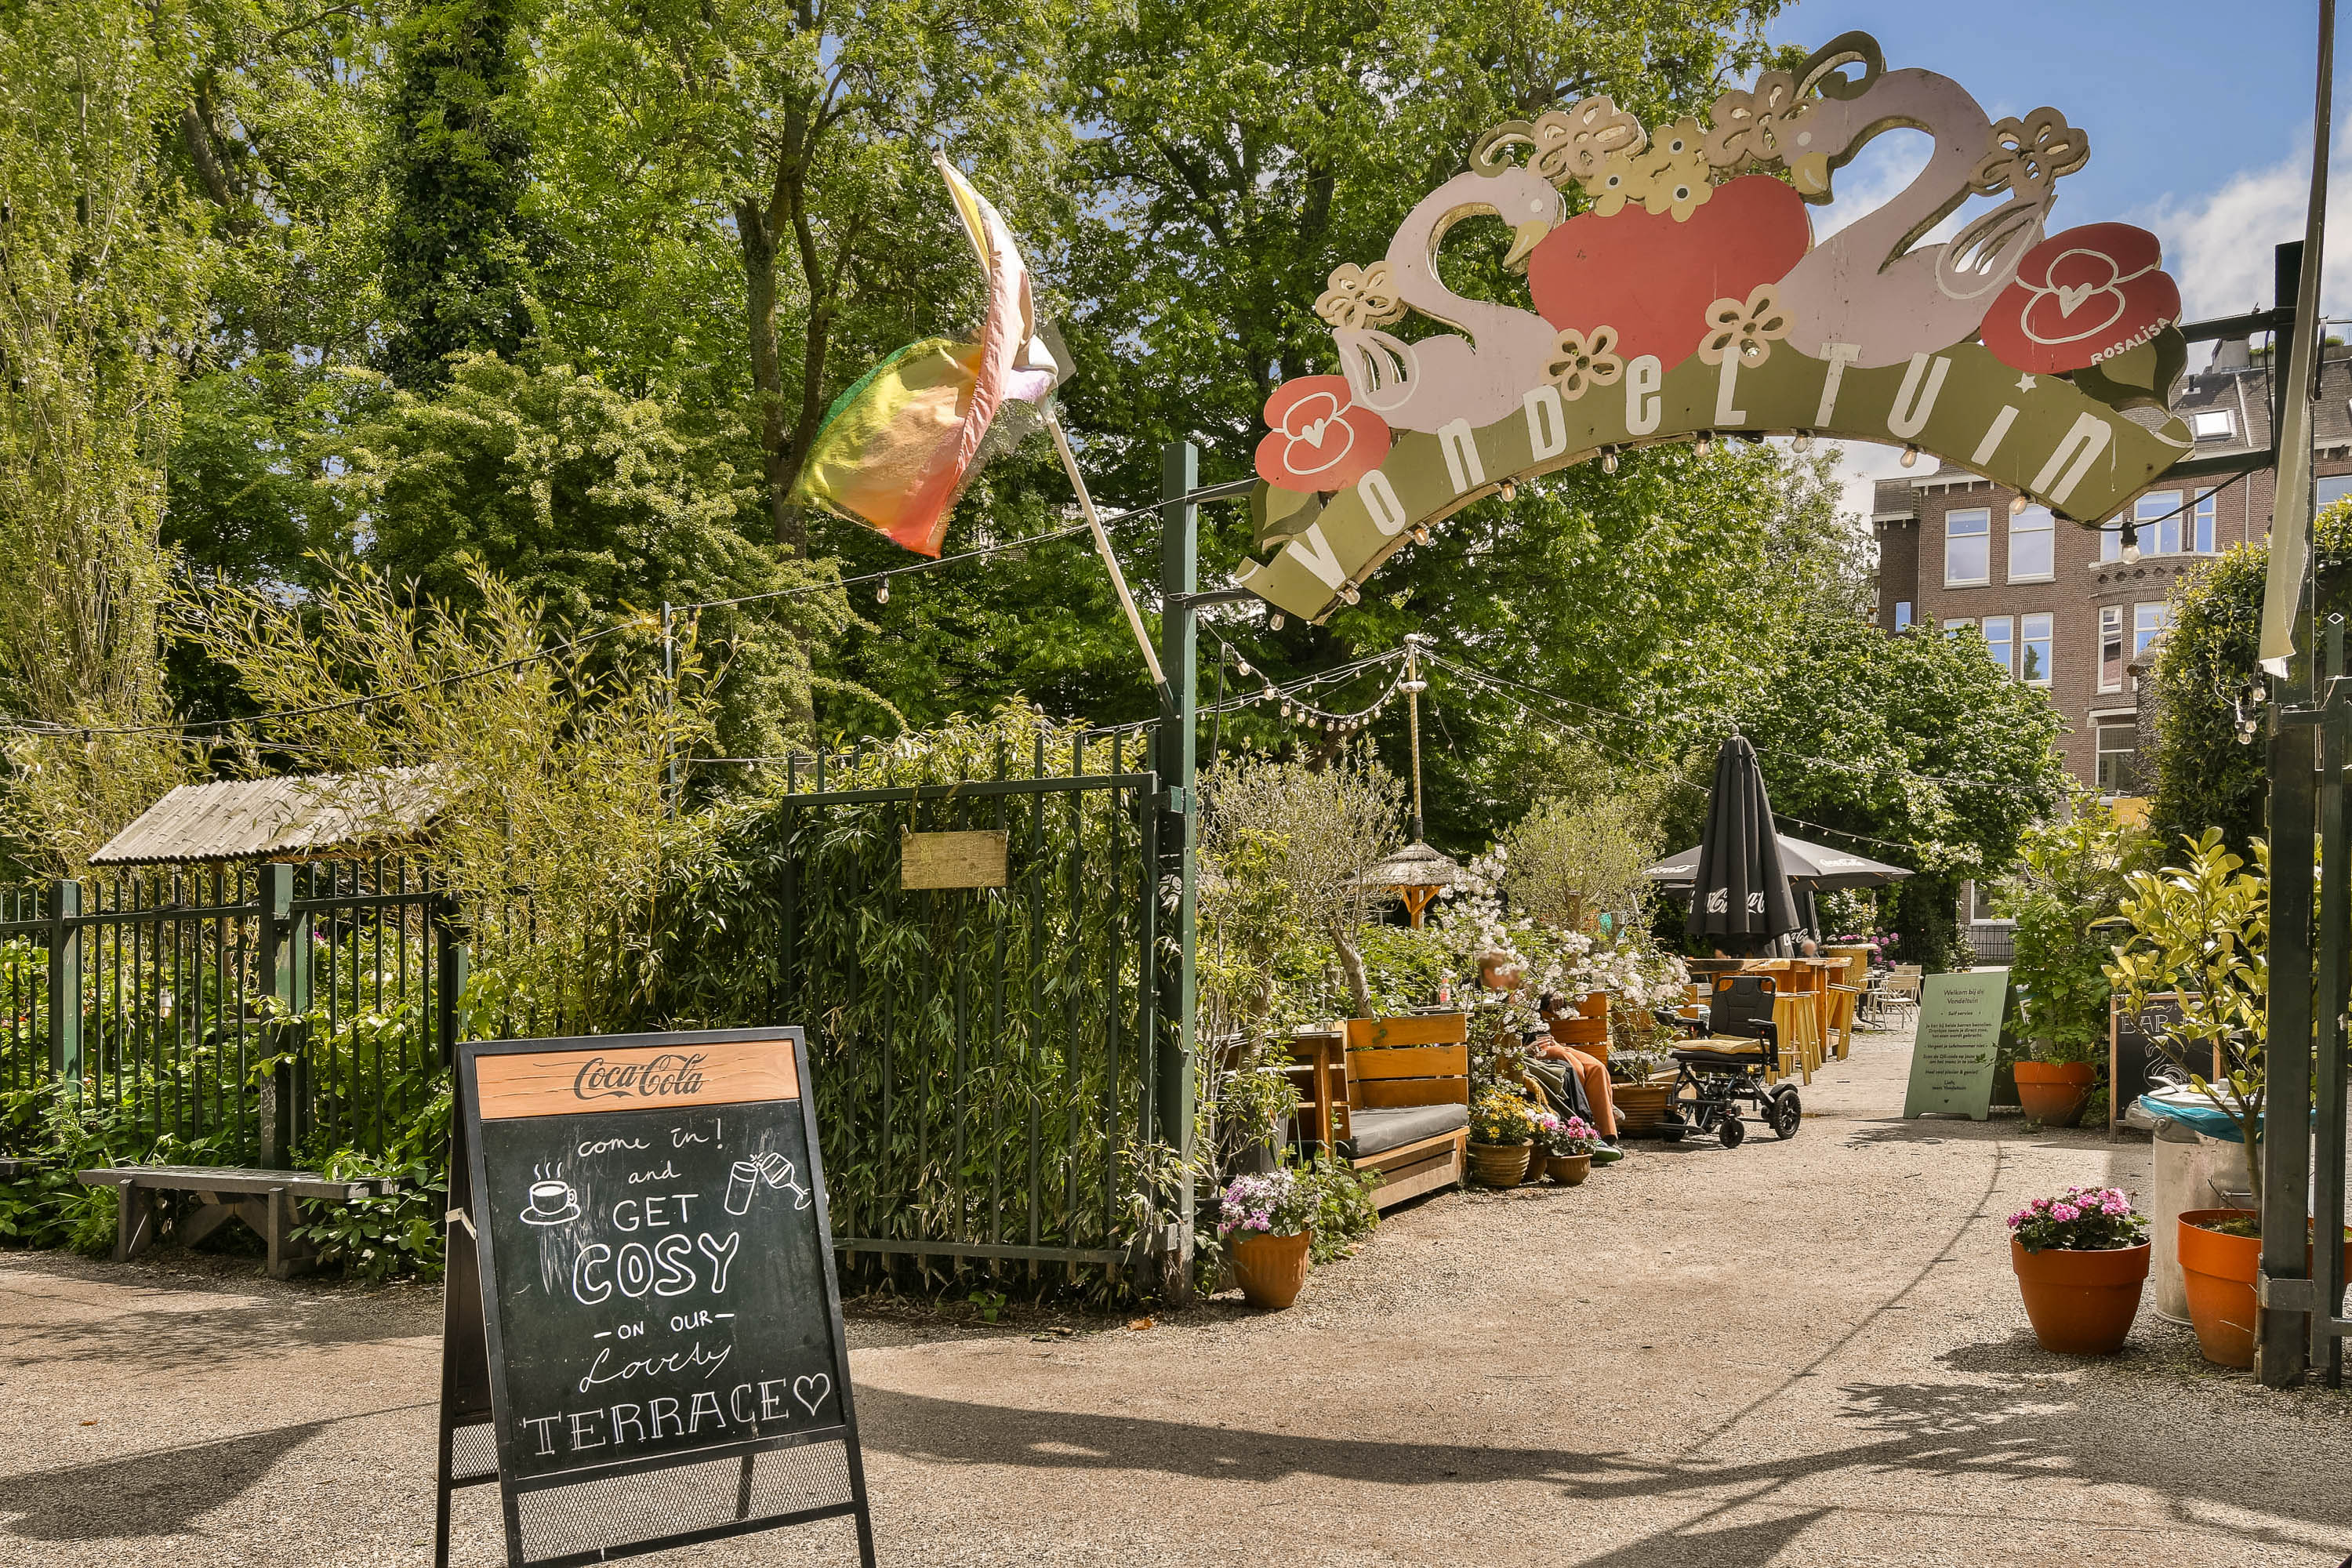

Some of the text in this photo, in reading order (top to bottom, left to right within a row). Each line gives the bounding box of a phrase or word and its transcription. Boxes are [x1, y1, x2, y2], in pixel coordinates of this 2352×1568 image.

[574, 1053, 708, 1100] Coca-Cola
[578, 1137, 652, 1158] come
[627, 1160, 682, 1185] and
[613, 1193, 699, 1232] GET
[572, 1232, 741, 1305] COSY
[521, 1377, 789, 1457] TERRACE
